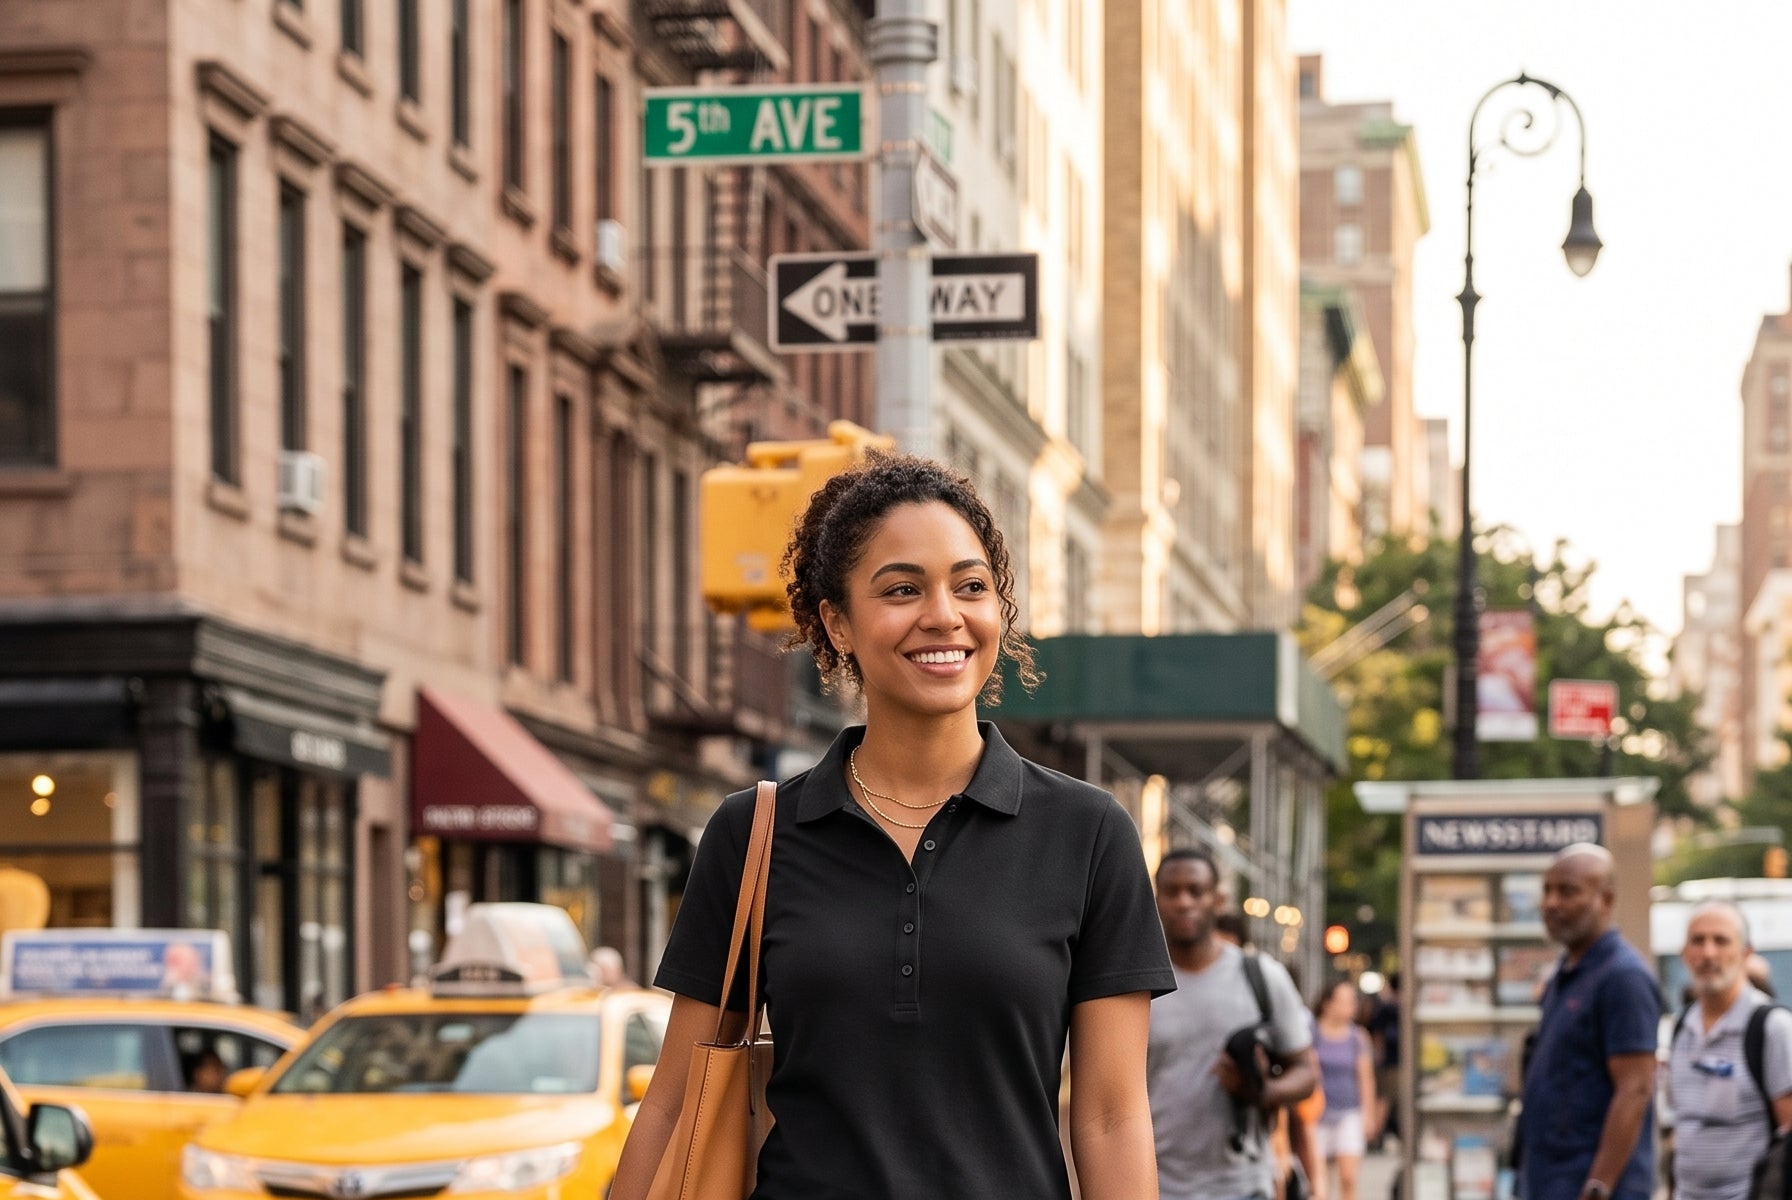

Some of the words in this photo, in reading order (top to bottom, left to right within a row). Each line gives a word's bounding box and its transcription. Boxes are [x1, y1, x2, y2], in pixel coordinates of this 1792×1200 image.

[666, 101, 731, 154] 5th
[751, 97, 842, 150] AVE
[932, 280, 1005, 314] WAY
